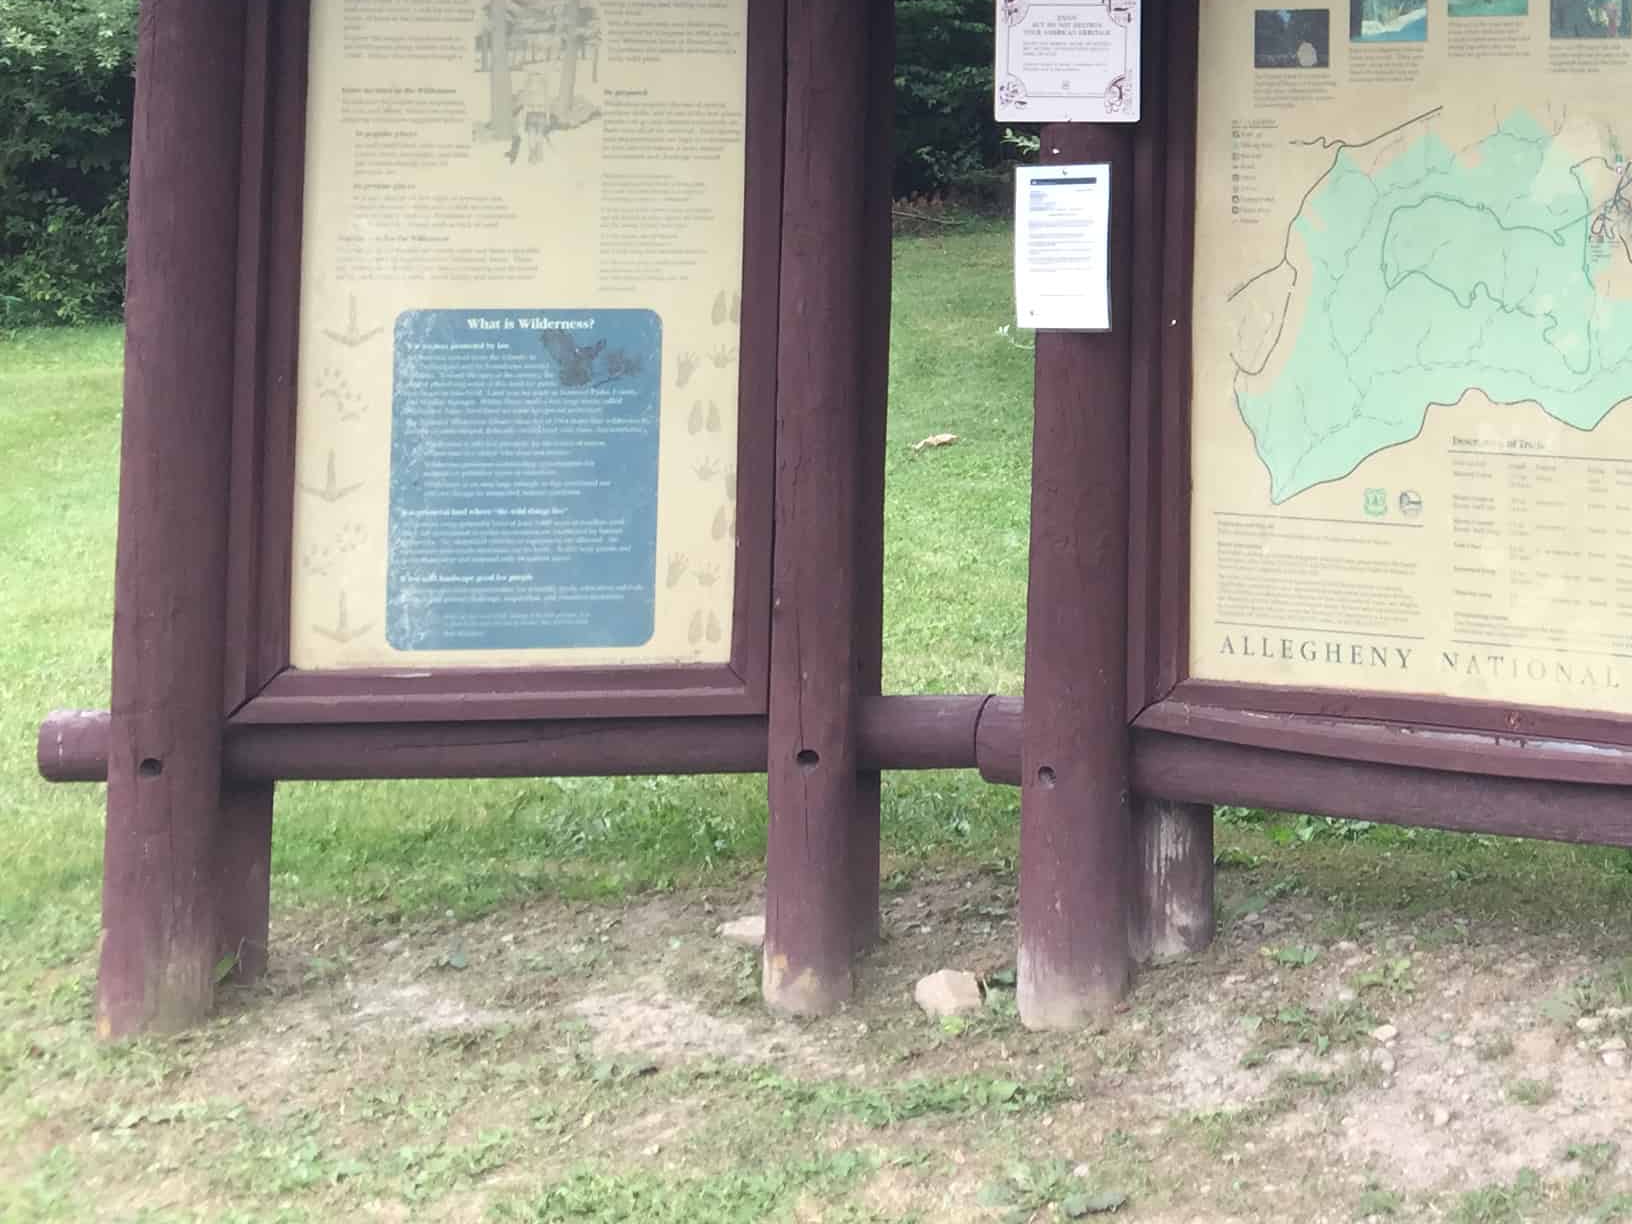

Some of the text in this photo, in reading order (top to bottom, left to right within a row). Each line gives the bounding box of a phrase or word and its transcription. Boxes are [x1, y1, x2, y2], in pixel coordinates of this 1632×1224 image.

[468, 318, 594, 330] What is Wilderness?
[1219, 634, 1414, 668] ALLEGHENY
[1442, 652, 1620, 690] NATIONAL
